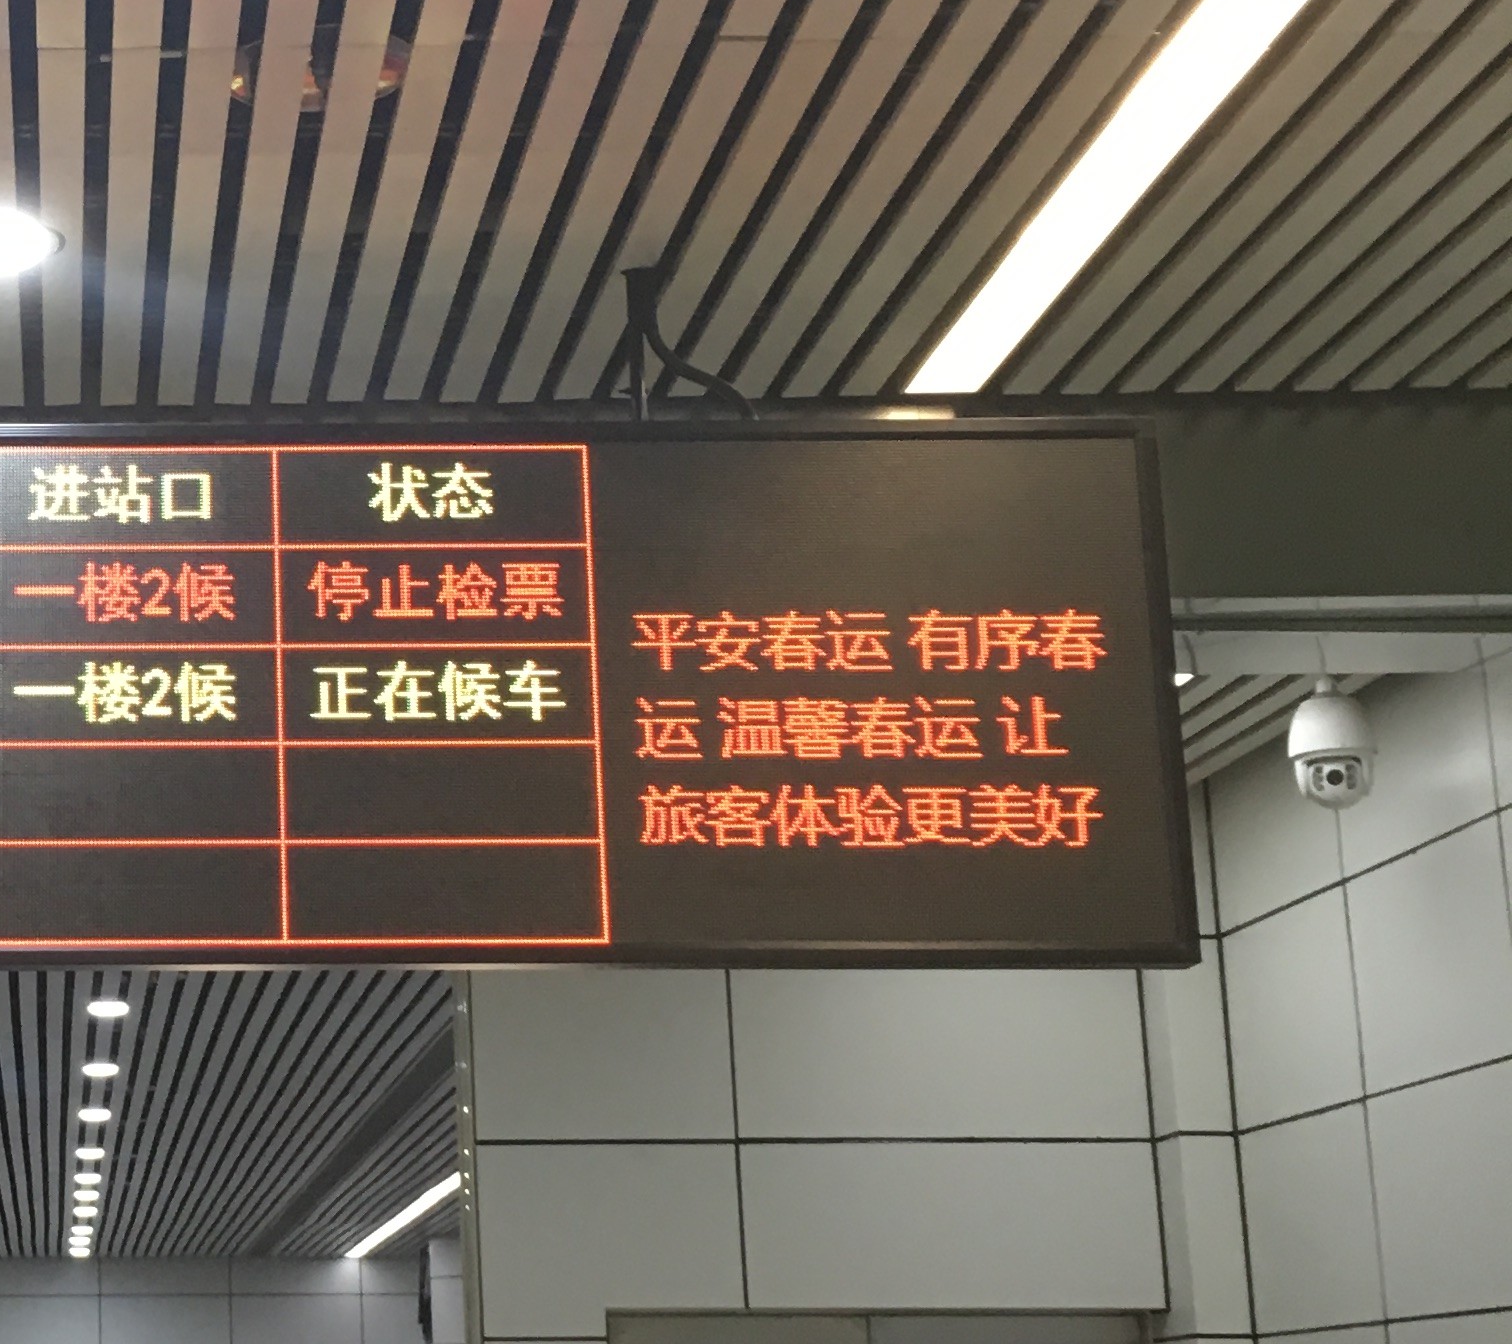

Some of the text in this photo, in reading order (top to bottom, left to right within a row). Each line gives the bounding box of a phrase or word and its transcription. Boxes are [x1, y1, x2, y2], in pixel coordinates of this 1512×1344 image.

[28, 465, 213, 524] 进站口
[367, 462, 494, 522] 状态
[13, 560, 236, 623] 一楼2候
[307, 560, 564, 621] 停止检票
[632, 608, 1108, 672] 平安春运 有序春
[13, 661, 237, 724] 一楼2候
[309, 659, 566, 722] 正在候车
[635, 695, 1069, 760] 运 温馨春运 让
[638, 783, 1104, 848] 旅客体验更美好
